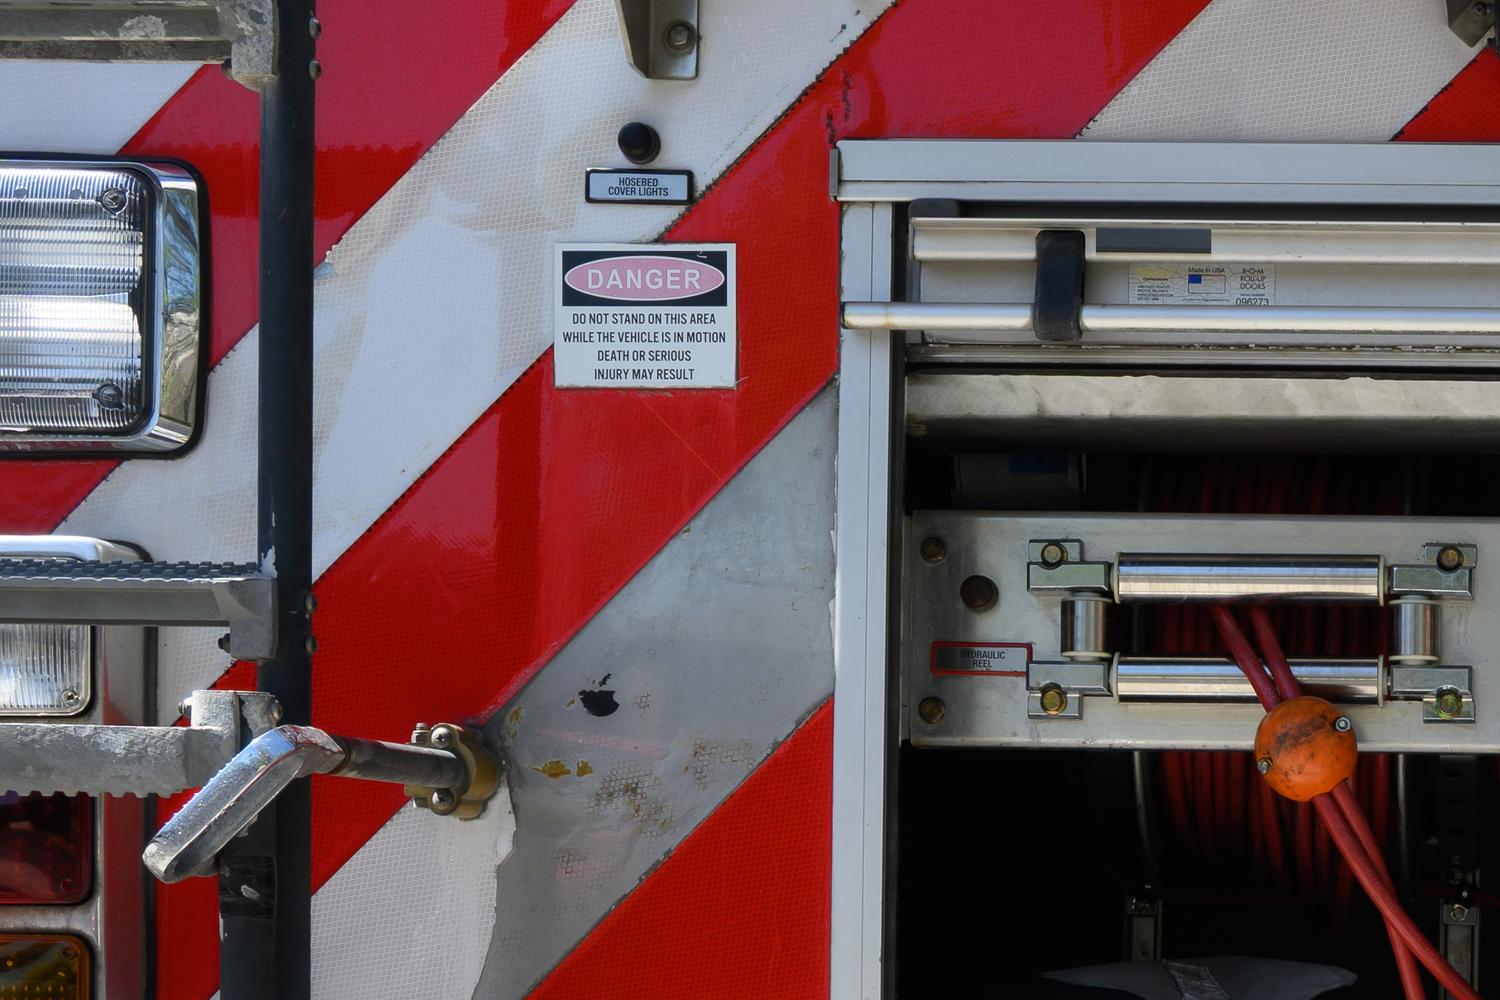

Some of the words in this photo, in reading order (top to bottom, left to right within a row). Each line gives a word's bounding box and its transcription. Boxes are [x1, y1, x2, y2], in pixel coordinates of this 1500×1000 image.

[619, 178, 658, 186] HOSEBED
[608, 187, 636, 196] COVER
[639, 187, 668, 196] LIGHTS
[587, 269, 701, 289] DANGER
[1240, 282, 1266, 290] DOORS
[1236, 298, 1269, 306] 096273
[573, 313, 586, 324] DO
[589, 313, 609, 324] NOT
[612, 313, 644, 324] STAND
[648, 313, 662, 324] ON
[665, 313, 687, 324] THIS
[690, 313, 716, 324] AREA
[563, 332, 594, 343] WHILE
[597, 332, 614, 343] THE
[618, 332, 659, 343] VEHICLE
[662, 332, 670, 343] IS
[674, 332, 683, 343] IN
[686, 332, 725, 343] MOTION
[597, 351, 629, 361] DEATH
[633, 351, 645, 361] OR
[649, 351, 691, 361] SERIOUS
[594, 369, 629, 380] INJURY
[632, 369, 654, 380] MAY
[657, 369, 694, 380] RESULT
[960, 650, 1006, 659] HYDRAULIC
[972, 660, 992, 668] REEL
